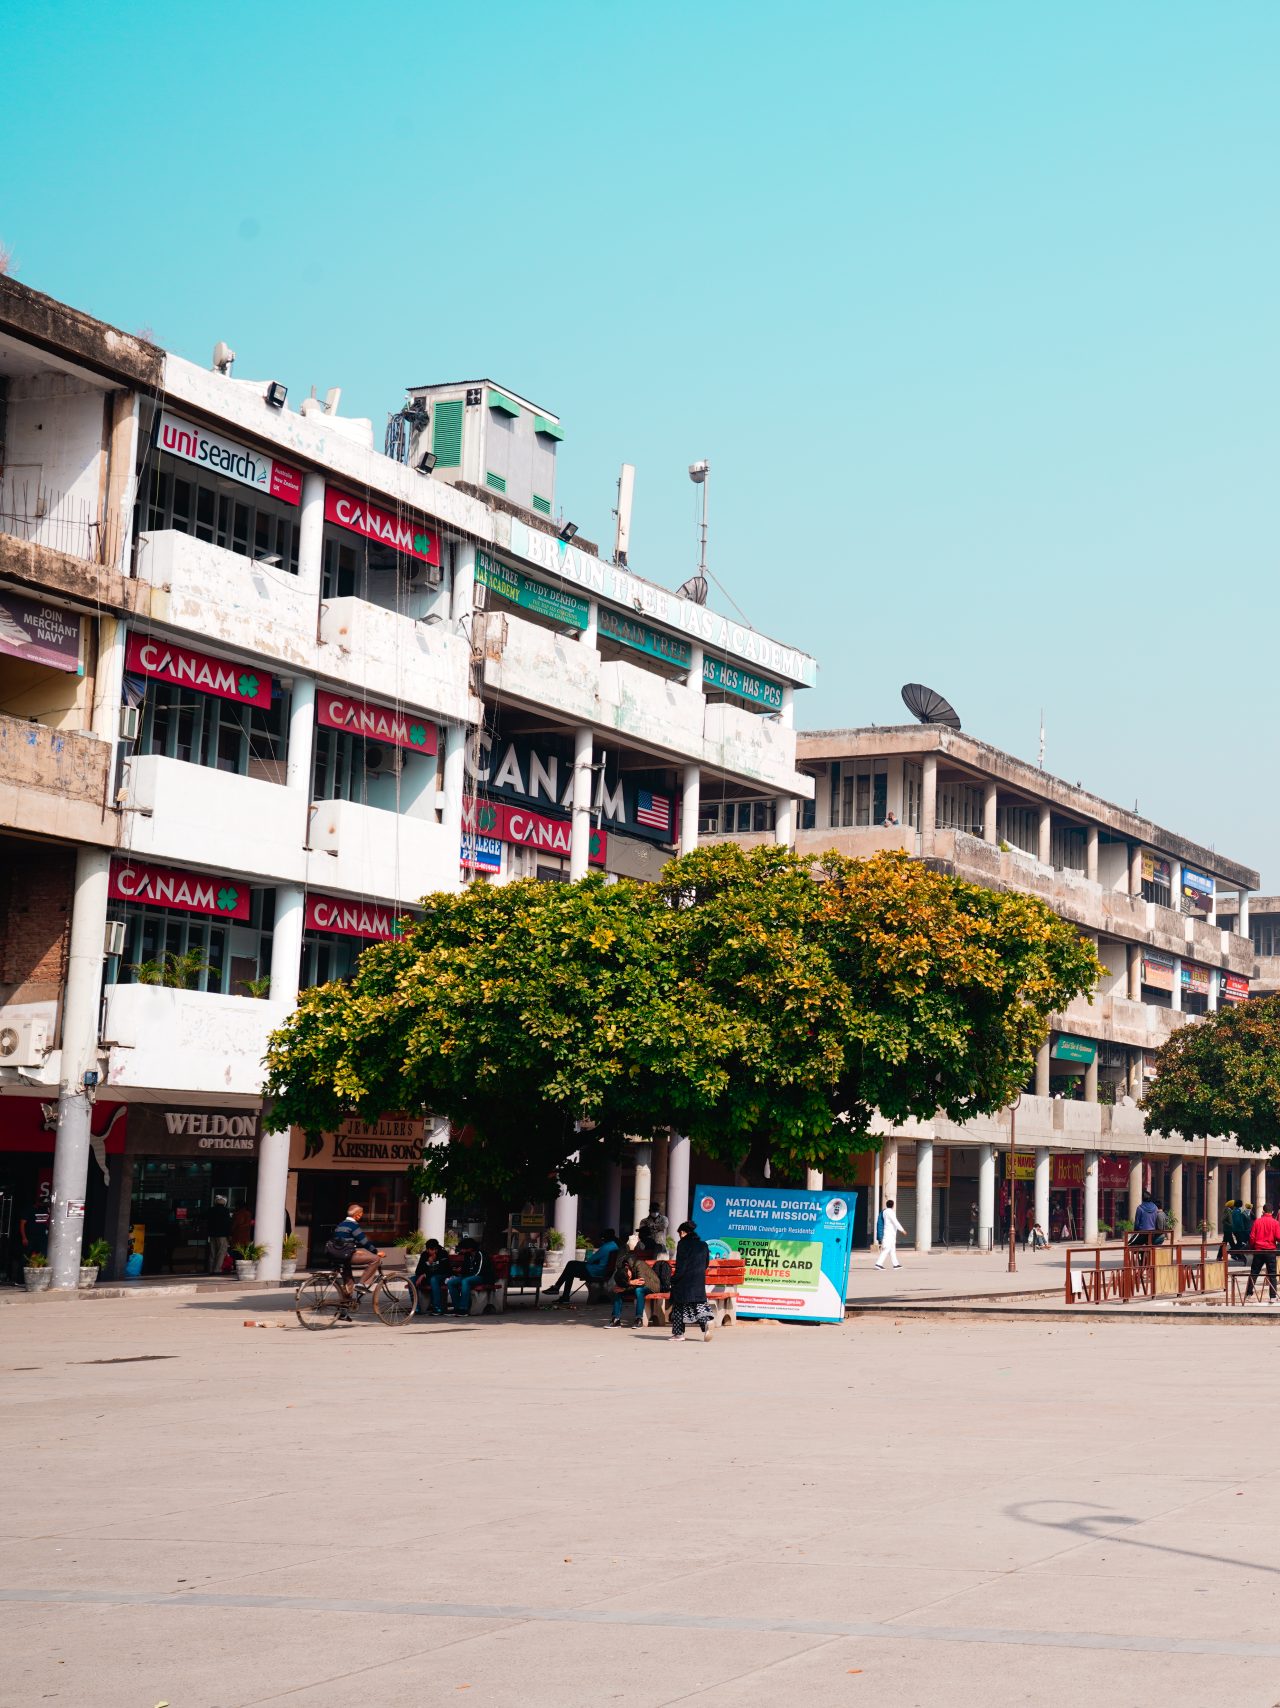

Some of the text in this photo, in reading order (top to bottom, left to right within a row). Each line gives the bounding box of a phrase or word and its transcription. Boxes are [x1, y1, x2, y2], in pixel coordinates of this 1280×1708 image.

[163, 424, 256, 482] unisearch
[336, 499, 413, 551] CANAM
[480, 554, 519, 586] BRAIN TREE
[488, 576, 520, 601] ACADEMY
[524, 581, 549, 597] STUDY
[40, 608, 63, 622] JOIN
[527, 529, 607, 598] BRAIN
[679, 599, 713, 640] IAS
[718, 619, 808, 680] ACADEMY
[24, 613, 78, 638] MERCHANT
[37, 628, 64, 645] NAVY
[600, 611, 689, 664] BRAIN TREE
[139, 644, 236, 695] CANAM
[719, 665, 738, 689] HCS
[742, 676, 759, 697] HAS
[763, 684, 781, 706] PCS
[328, 700, 409, 743] CANAM
[510, 814, 573, 851] CANA
[116, 868, 216, 910] CANAM
[313, 902, 390, 936] CANAM
[165, 1112, 258, 1137] WELDON
[347, 1121, 413, 1137] JEWELLERS
[198, 1137, 254, 1150] OPTICIANS
[332, 1135, 389, 1159] KRISHNA
[725, 1198, 823, 1211] NATIONAL DIGITAL
[728, 1209, 817, 1221] HEALTH MISSION
[728, 1224, 757, 1232] ATTENTION
[758, 1226, 787, 1234] Chandigarh
[743, 1258, 813, 1270] EALTH CARD
[749, 1268, 791, 1277] MINUTES
